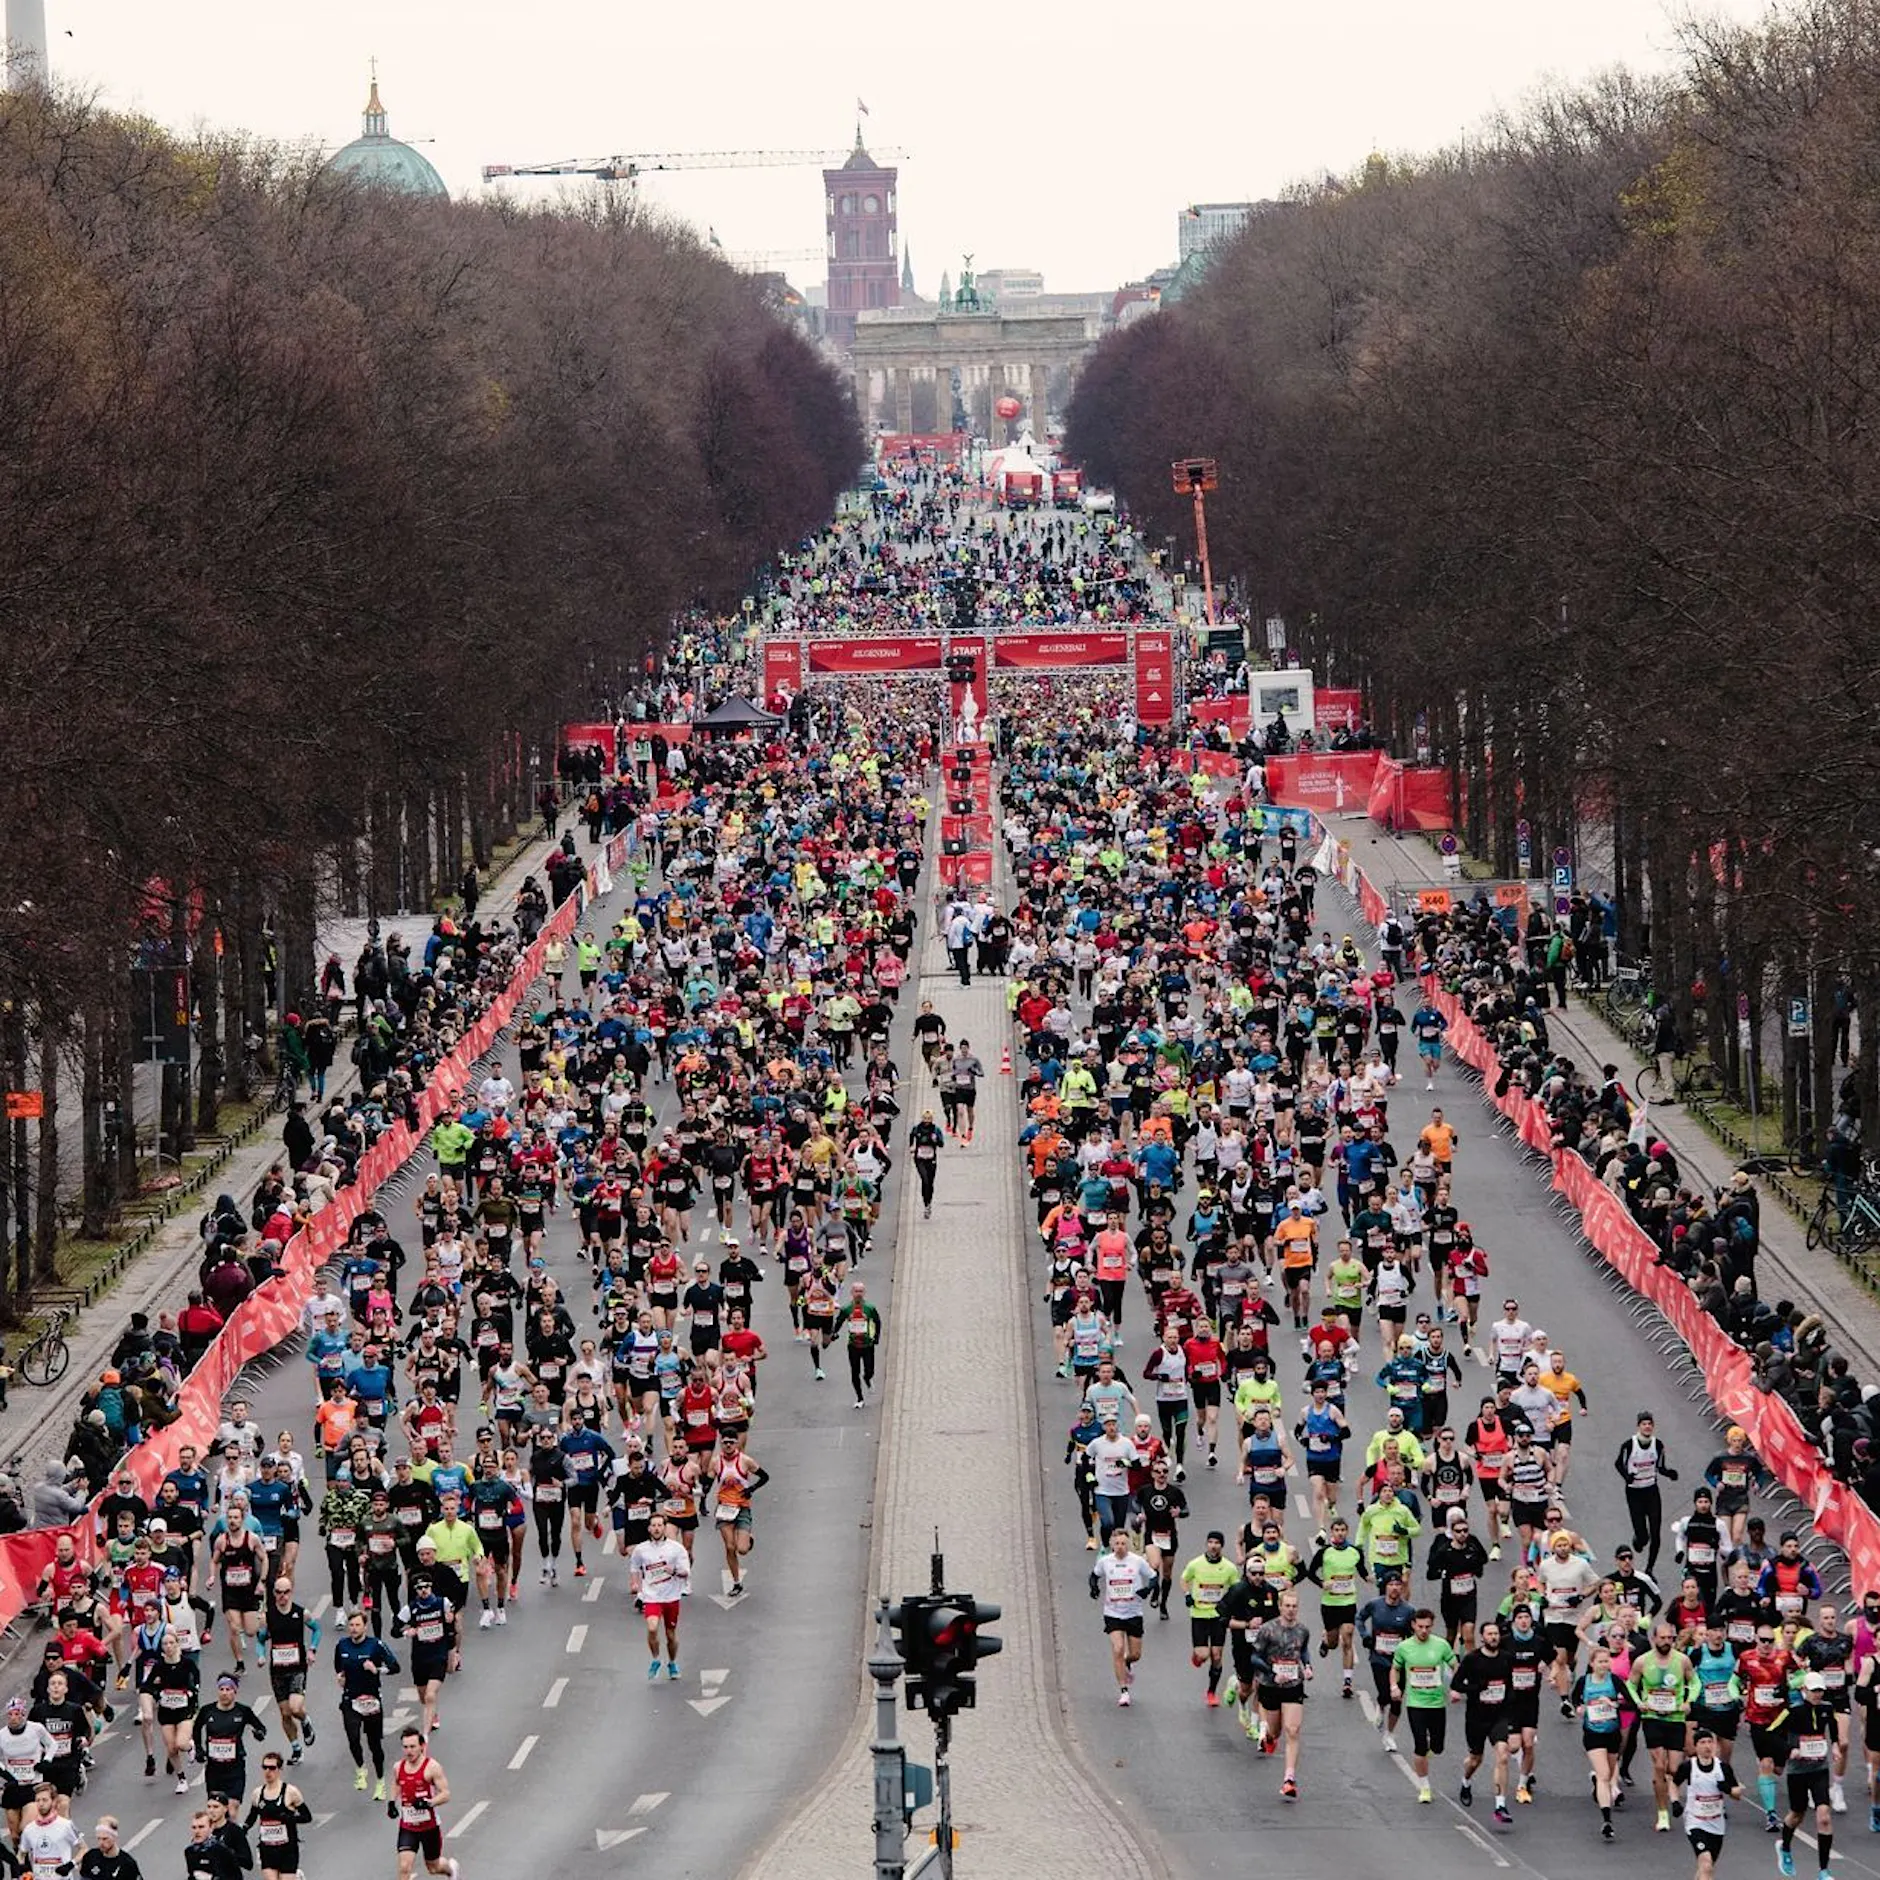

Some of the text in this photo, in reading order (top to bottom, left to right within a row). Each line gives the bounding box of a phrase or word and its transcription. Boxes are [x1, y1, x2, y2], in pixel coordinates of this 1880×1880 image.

[952, 646, 984, 657] START
[1556, 868, 1567, 885] P
[1502, 888, 1523, 898] K39
[1424, 895, 1445, 905] K40
[1792, 1000, 1804, 1021] P
